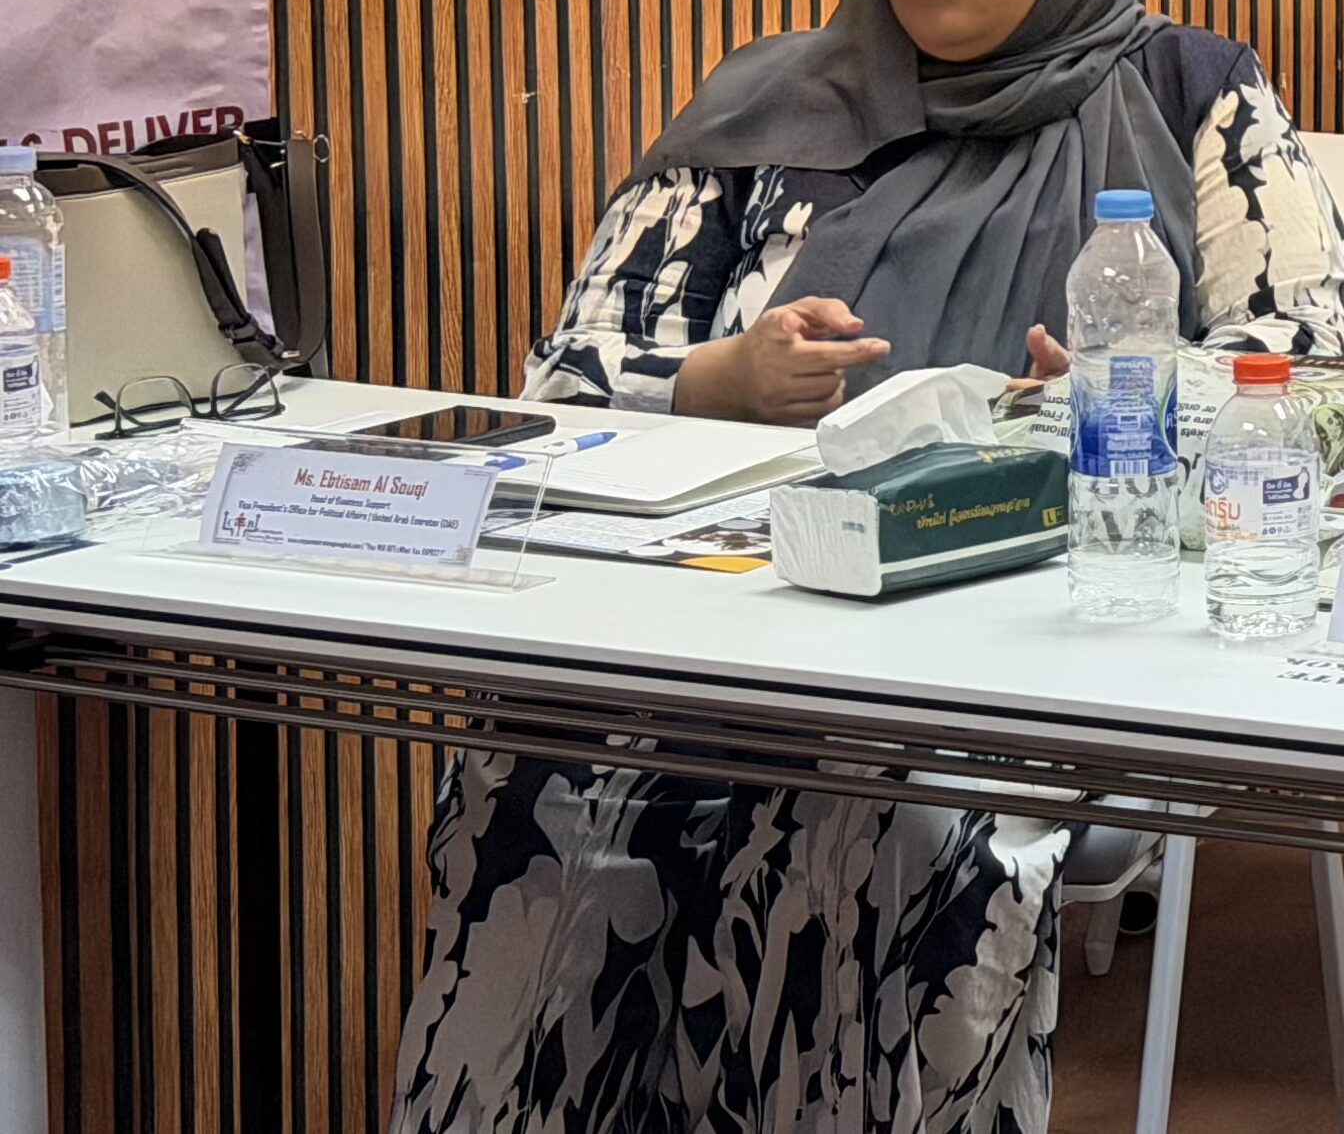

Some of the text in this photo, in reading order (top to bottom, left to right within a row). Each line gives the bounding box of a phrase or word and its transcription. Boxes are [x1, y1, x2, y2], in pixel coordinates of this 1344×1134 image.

[294, 468, 315, 487] Ms.
[320, 469, 371, 492] Ebtisam
[373, 475, 389, 493] Al
